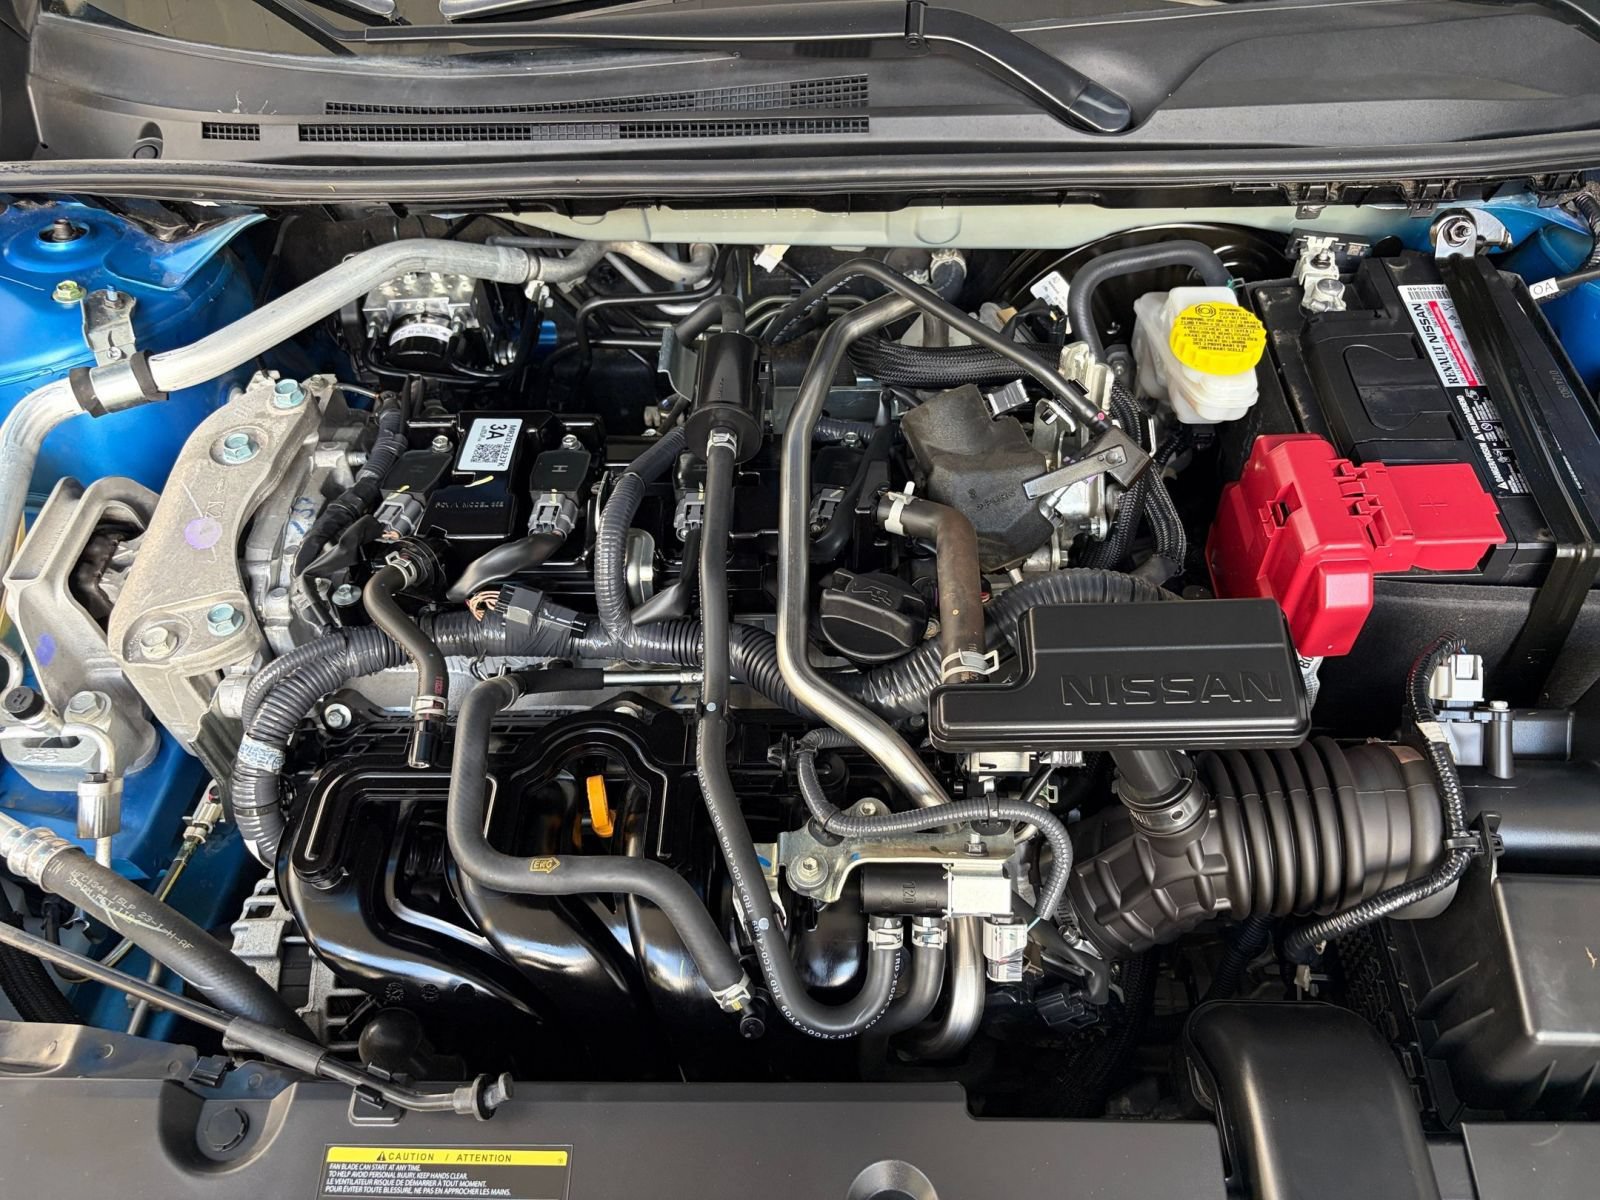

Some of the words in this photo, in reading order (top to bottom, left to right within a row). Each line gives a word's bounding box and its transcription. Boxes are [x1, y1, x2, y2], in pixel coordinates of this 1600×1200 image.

[1411, 303, 1440, 344] NISSAN
[1432, 345, 1459, 384] RENAULT
[486, 424, 508, 440] 3A
[1060, 672, 1283, 706] NISSAN
[388, 1153, 434, 1161] CAUTION
[456, 1154, 512, 1162] ATTENTION
